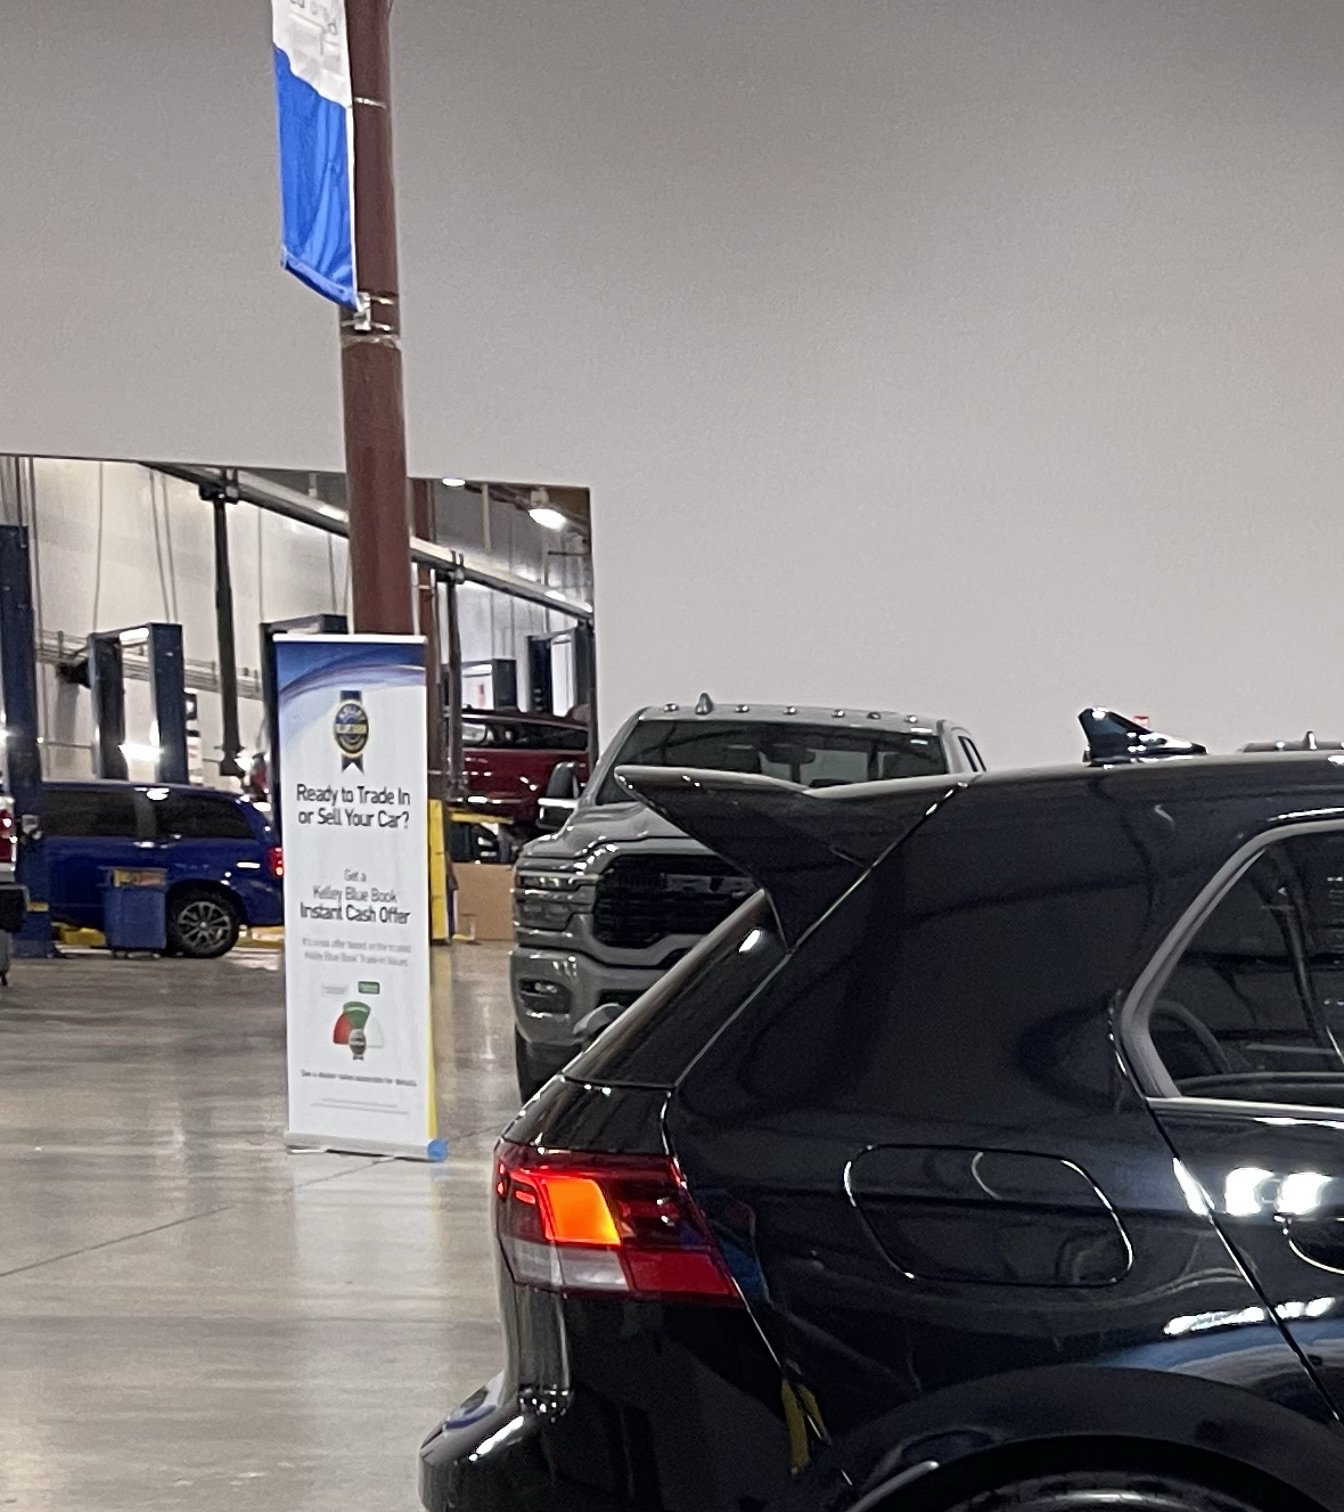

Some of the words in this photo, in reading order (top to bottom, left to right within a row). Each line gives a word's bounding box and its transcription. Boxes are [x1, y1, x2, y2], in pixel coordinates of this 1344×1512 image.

[296, 783, 338, 807] Ready
[341, 786, 354, 803] to
[357, 785, 395, 805] Trade
[397, 787, 411, 806] In
[297, 810, 314, 825] or
[317, 807, 342, 826] Sell
[344, 808, 375, 827] Your
[377, 809, 410, 829] Car?
[345, 886, 369, 901] Blue
[370, 887, 397, 903] Book
[300, 901, 343, 920] Instant
[345, 903, 377, 922] Cash
[379, 906, 411, 925] Offer
